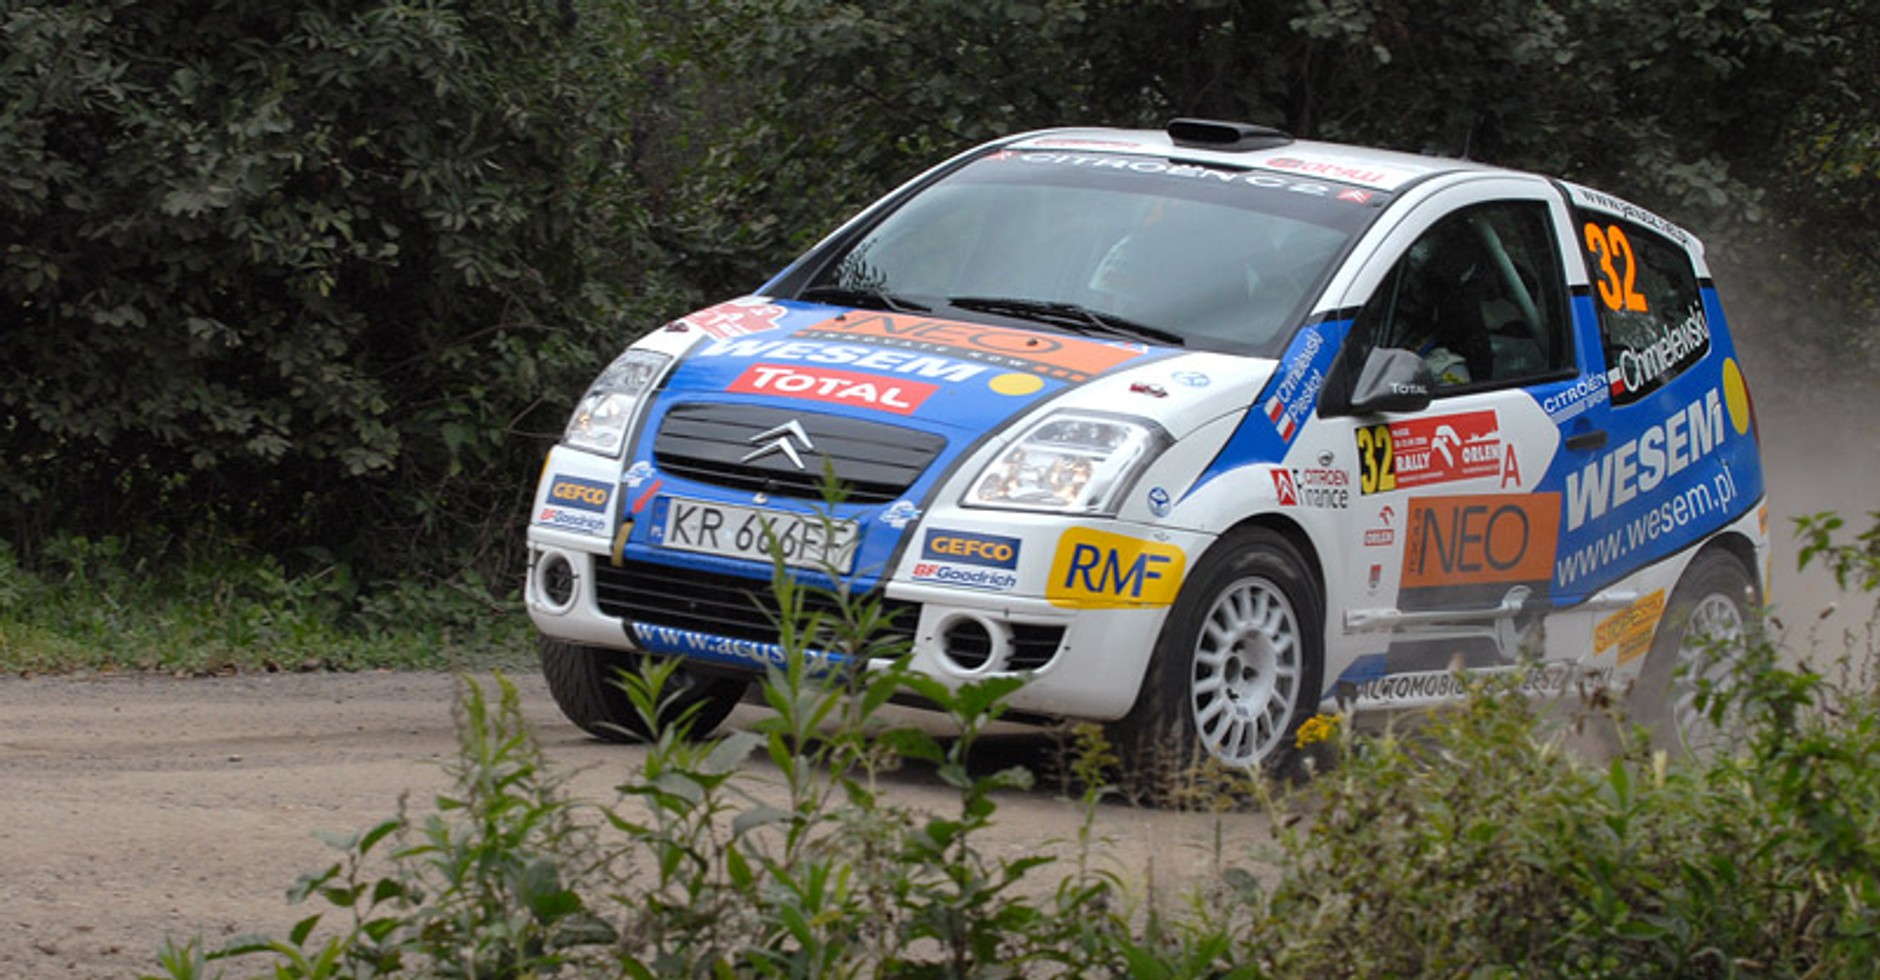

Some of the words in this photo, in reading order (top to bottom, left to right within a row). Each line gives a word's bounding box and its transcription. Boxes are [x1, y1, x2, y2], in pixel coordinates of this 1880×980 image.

[1583, 221, 1649, 313] 32
[843, 313, 1063, 354] NEO
[699, 338, 989, 383] WESEM
[752, 366, 911, 409] TOTAL
[1389, 381, 1428, 395] TOTAL
[1357, 424, 1396, 494] 32
[1395, 451, 1431, 472] RALLY
[1461, 443, 1500, 464] ORLEN
[1500, 442, 1522, 489] A
[1565, 387, 1725, 533] WESEM
[552, 481, 607, 505] GEFCO
[670, 503, 724, 549] KR
[1418, 504, 1530, 577] NEO
[1557, 458, 1738, 589] www.wesem.pl
[930, 536, 1014, 562] GEFCO
[1064, 542, 1171, 598] RMF
[913, 563, 1017, 587] BFGoodrich
